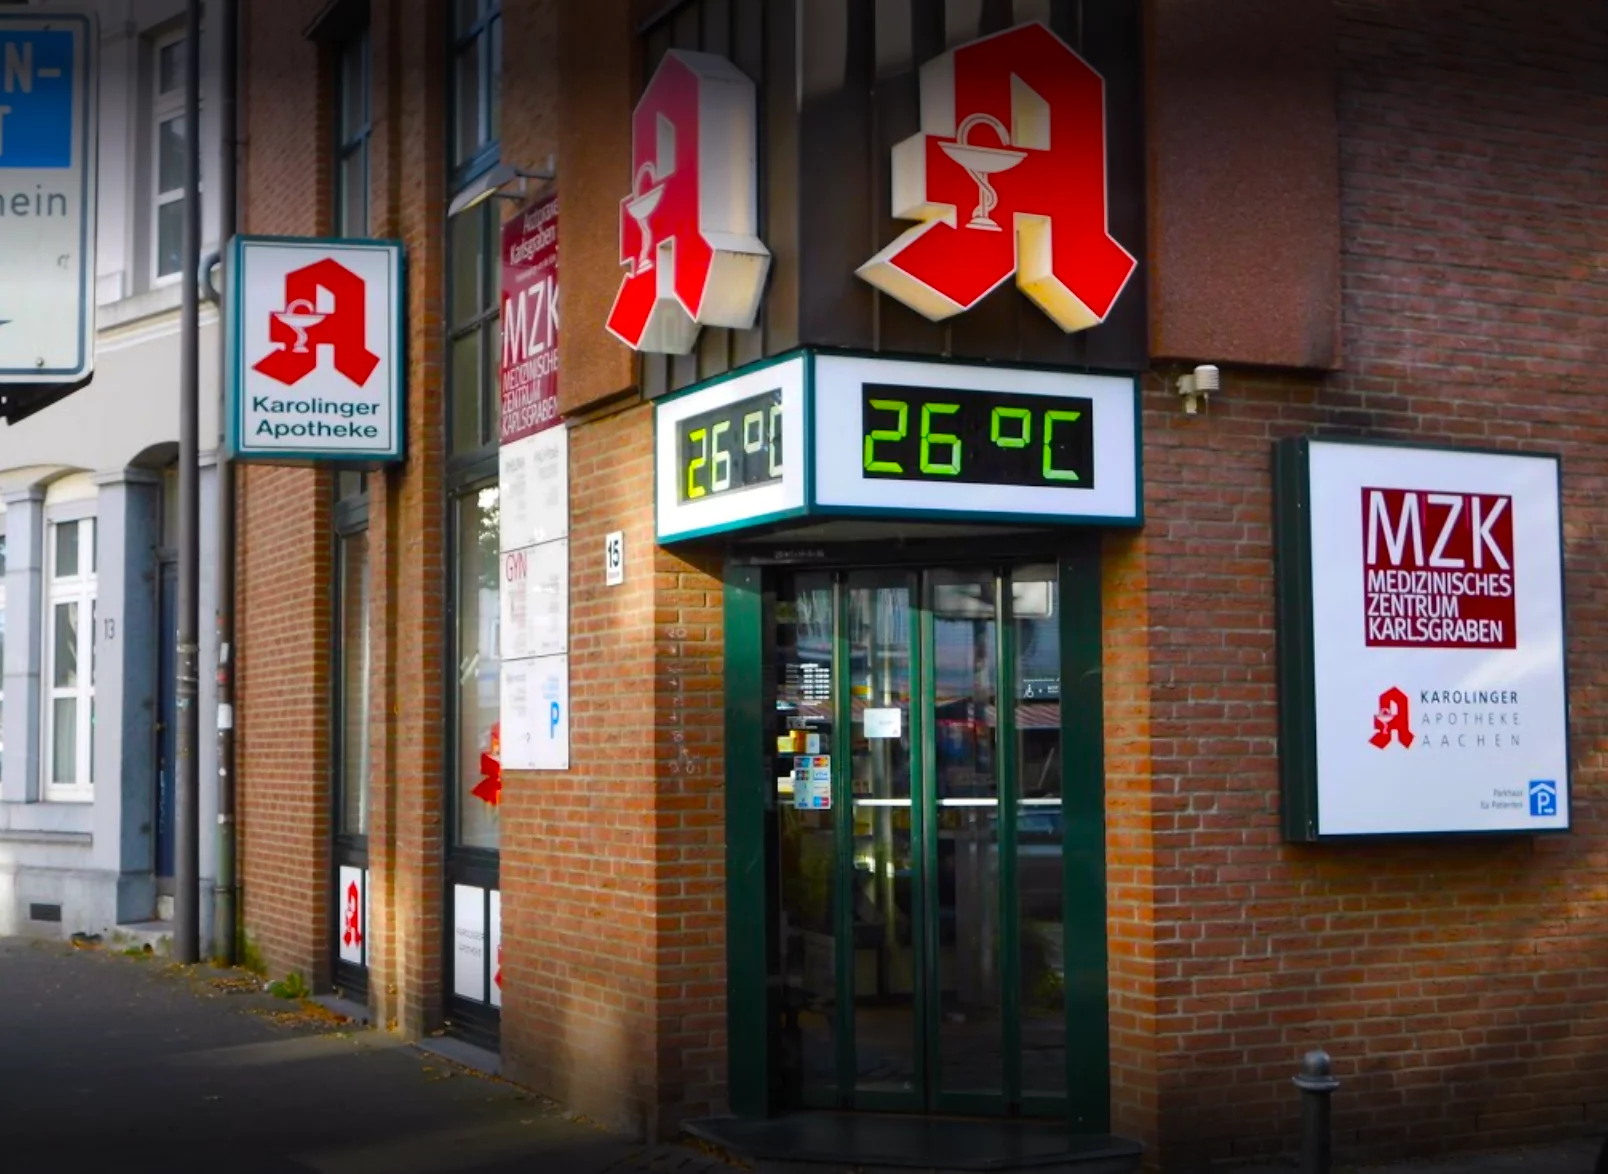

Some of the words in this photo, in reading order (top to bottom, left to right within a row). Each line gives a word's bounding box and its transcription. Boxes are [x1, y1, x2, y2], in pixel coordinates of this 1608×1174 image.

[501, 274, 559, 370] MZK
[252, 396, 381, 418] Karolinger
[502, 378, 541, 415] ZENTRUM
[255, 419, 379, 439] Apotheke
[863, 399, 960, 476] 26
[1366, 490, 1511, 570] MZK
[608, 540, 620, 568] 15
[1367, 569, 1513, 597] MEDIZINISCHES
[1367, 593, 1459, 618] ZENTRUM
[104, 618, 116, 640] 13
[1368, 617, 1504, 643] KARLSGRABEN
[1420, 690, 1519, 704] KAROLINGER
[1421, 712, 1521, 726] APOTHEKE
[1421, 733, 1521, 747] AACHEN
